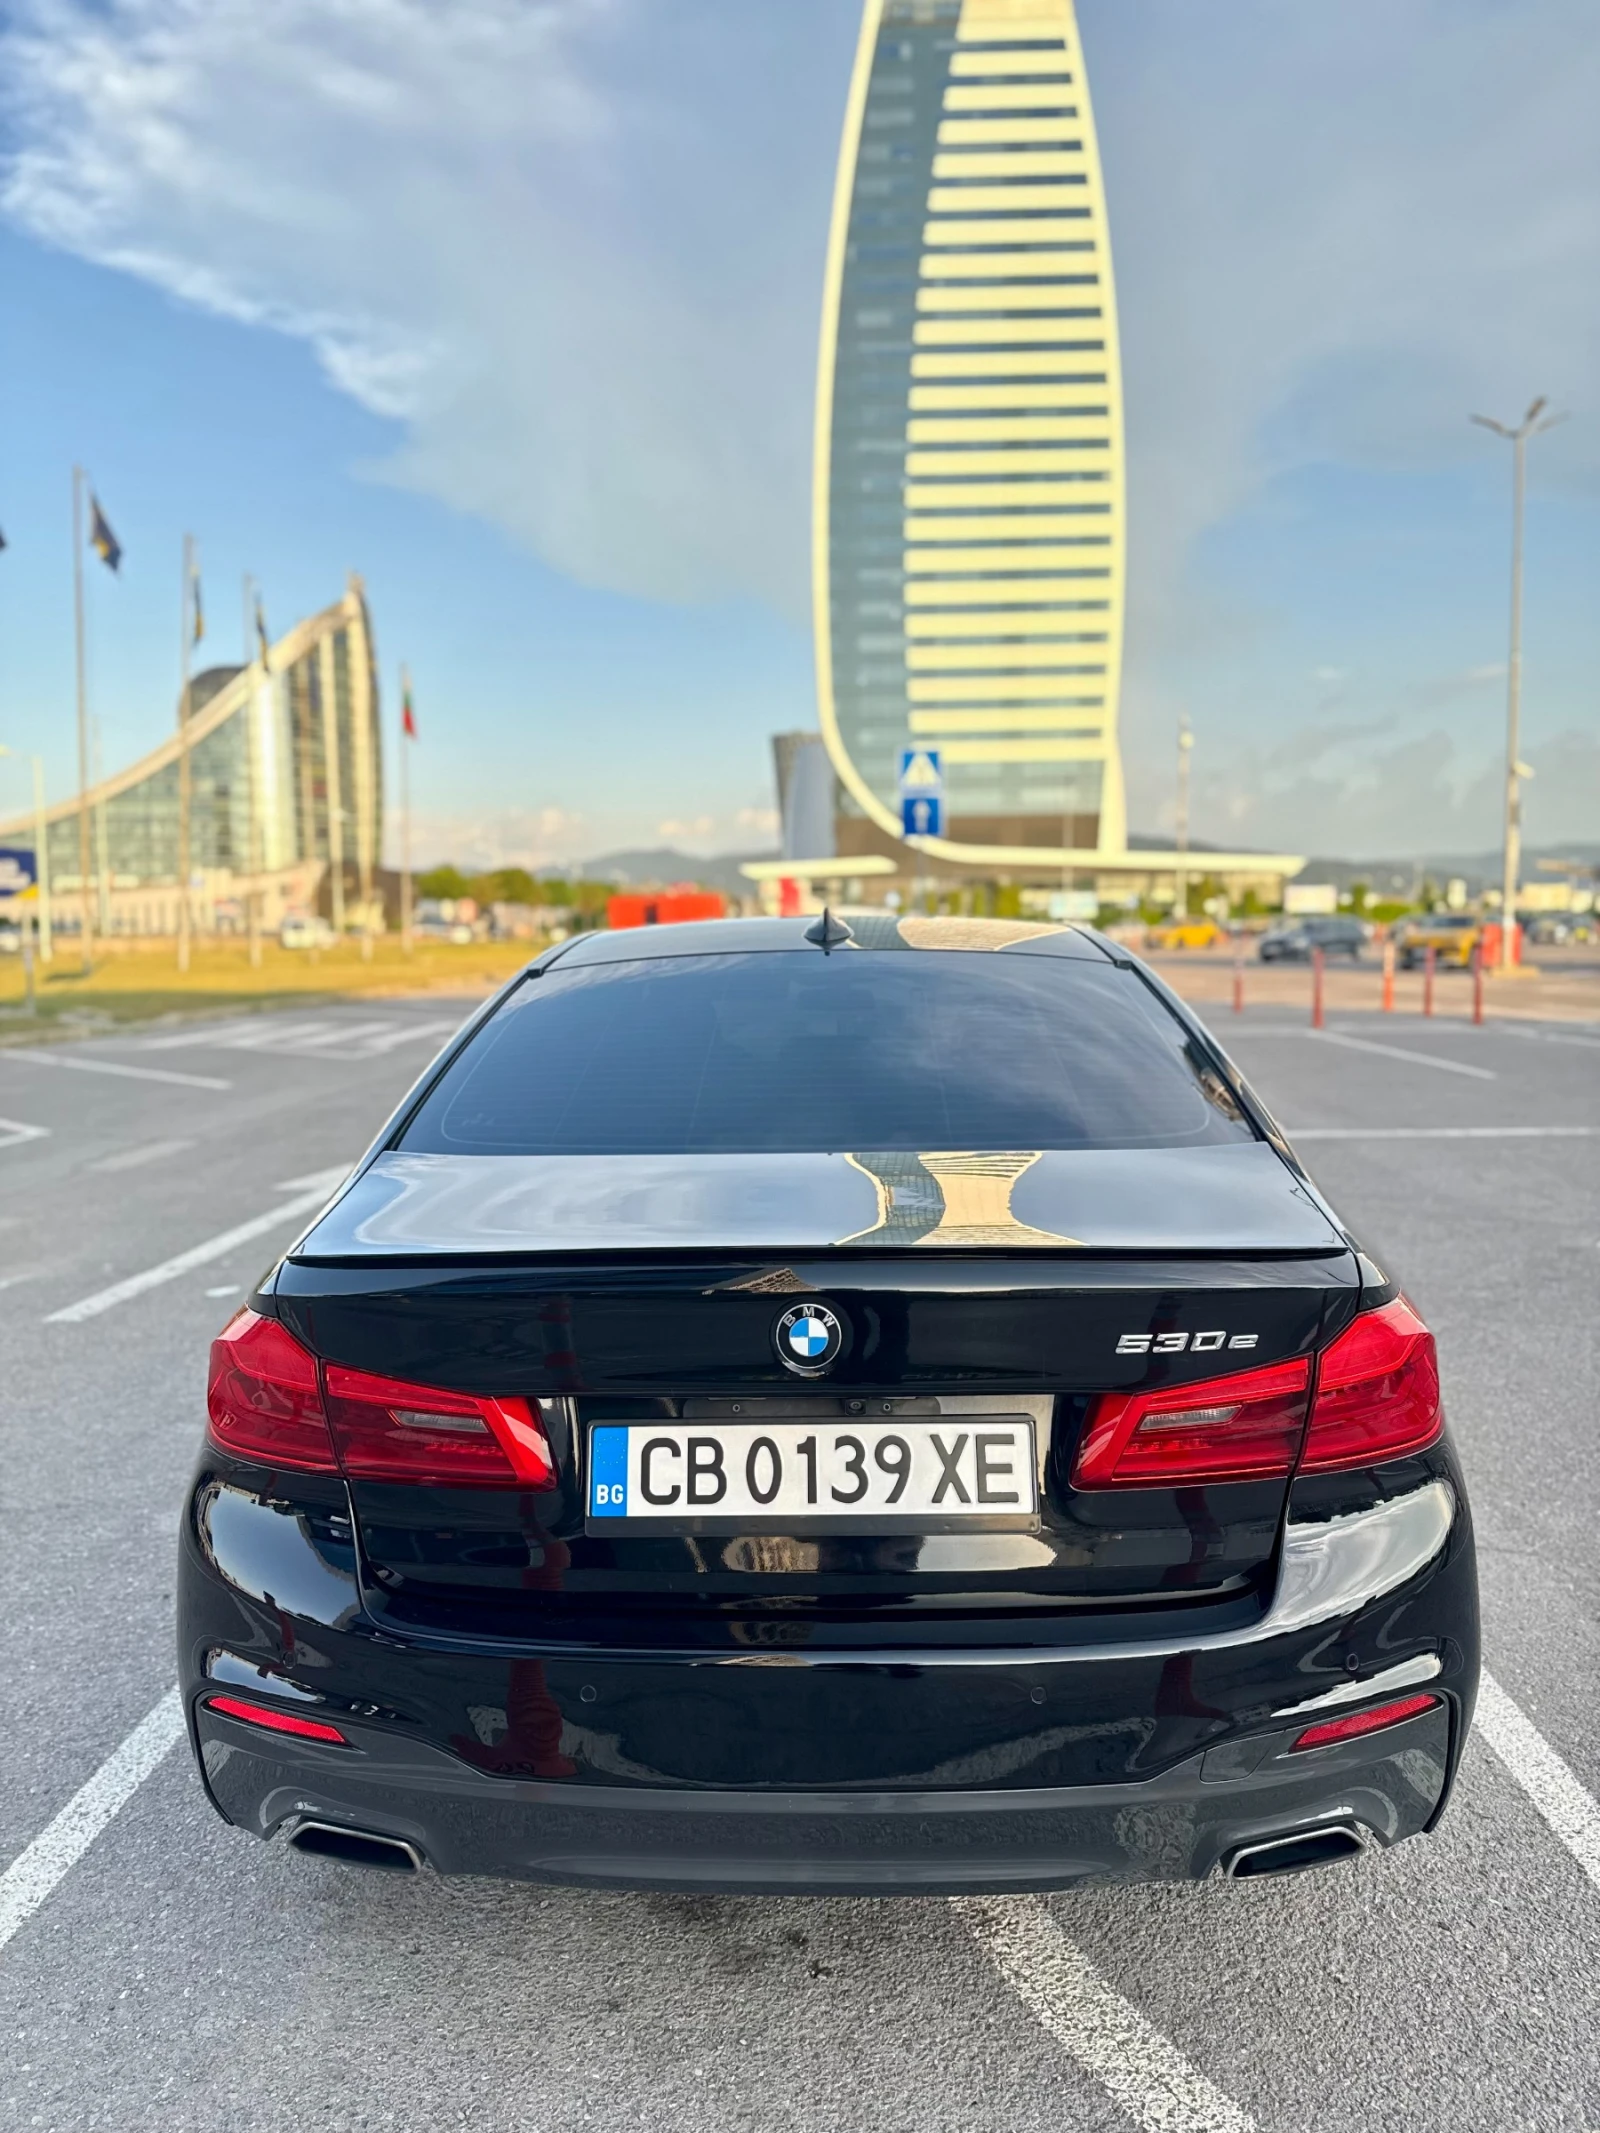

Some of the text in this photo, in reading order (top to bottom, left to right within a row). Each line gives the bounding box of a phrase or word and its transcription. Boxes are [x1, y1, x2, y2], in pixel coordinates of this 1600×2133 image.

[782, 1306, 835, 1327] BMW
[1115, 1331, 1259, 1354] 530e
[640, 1433, 1019, 1505] CB 0139 XE
[596, 1484, 624, 1505] BG
